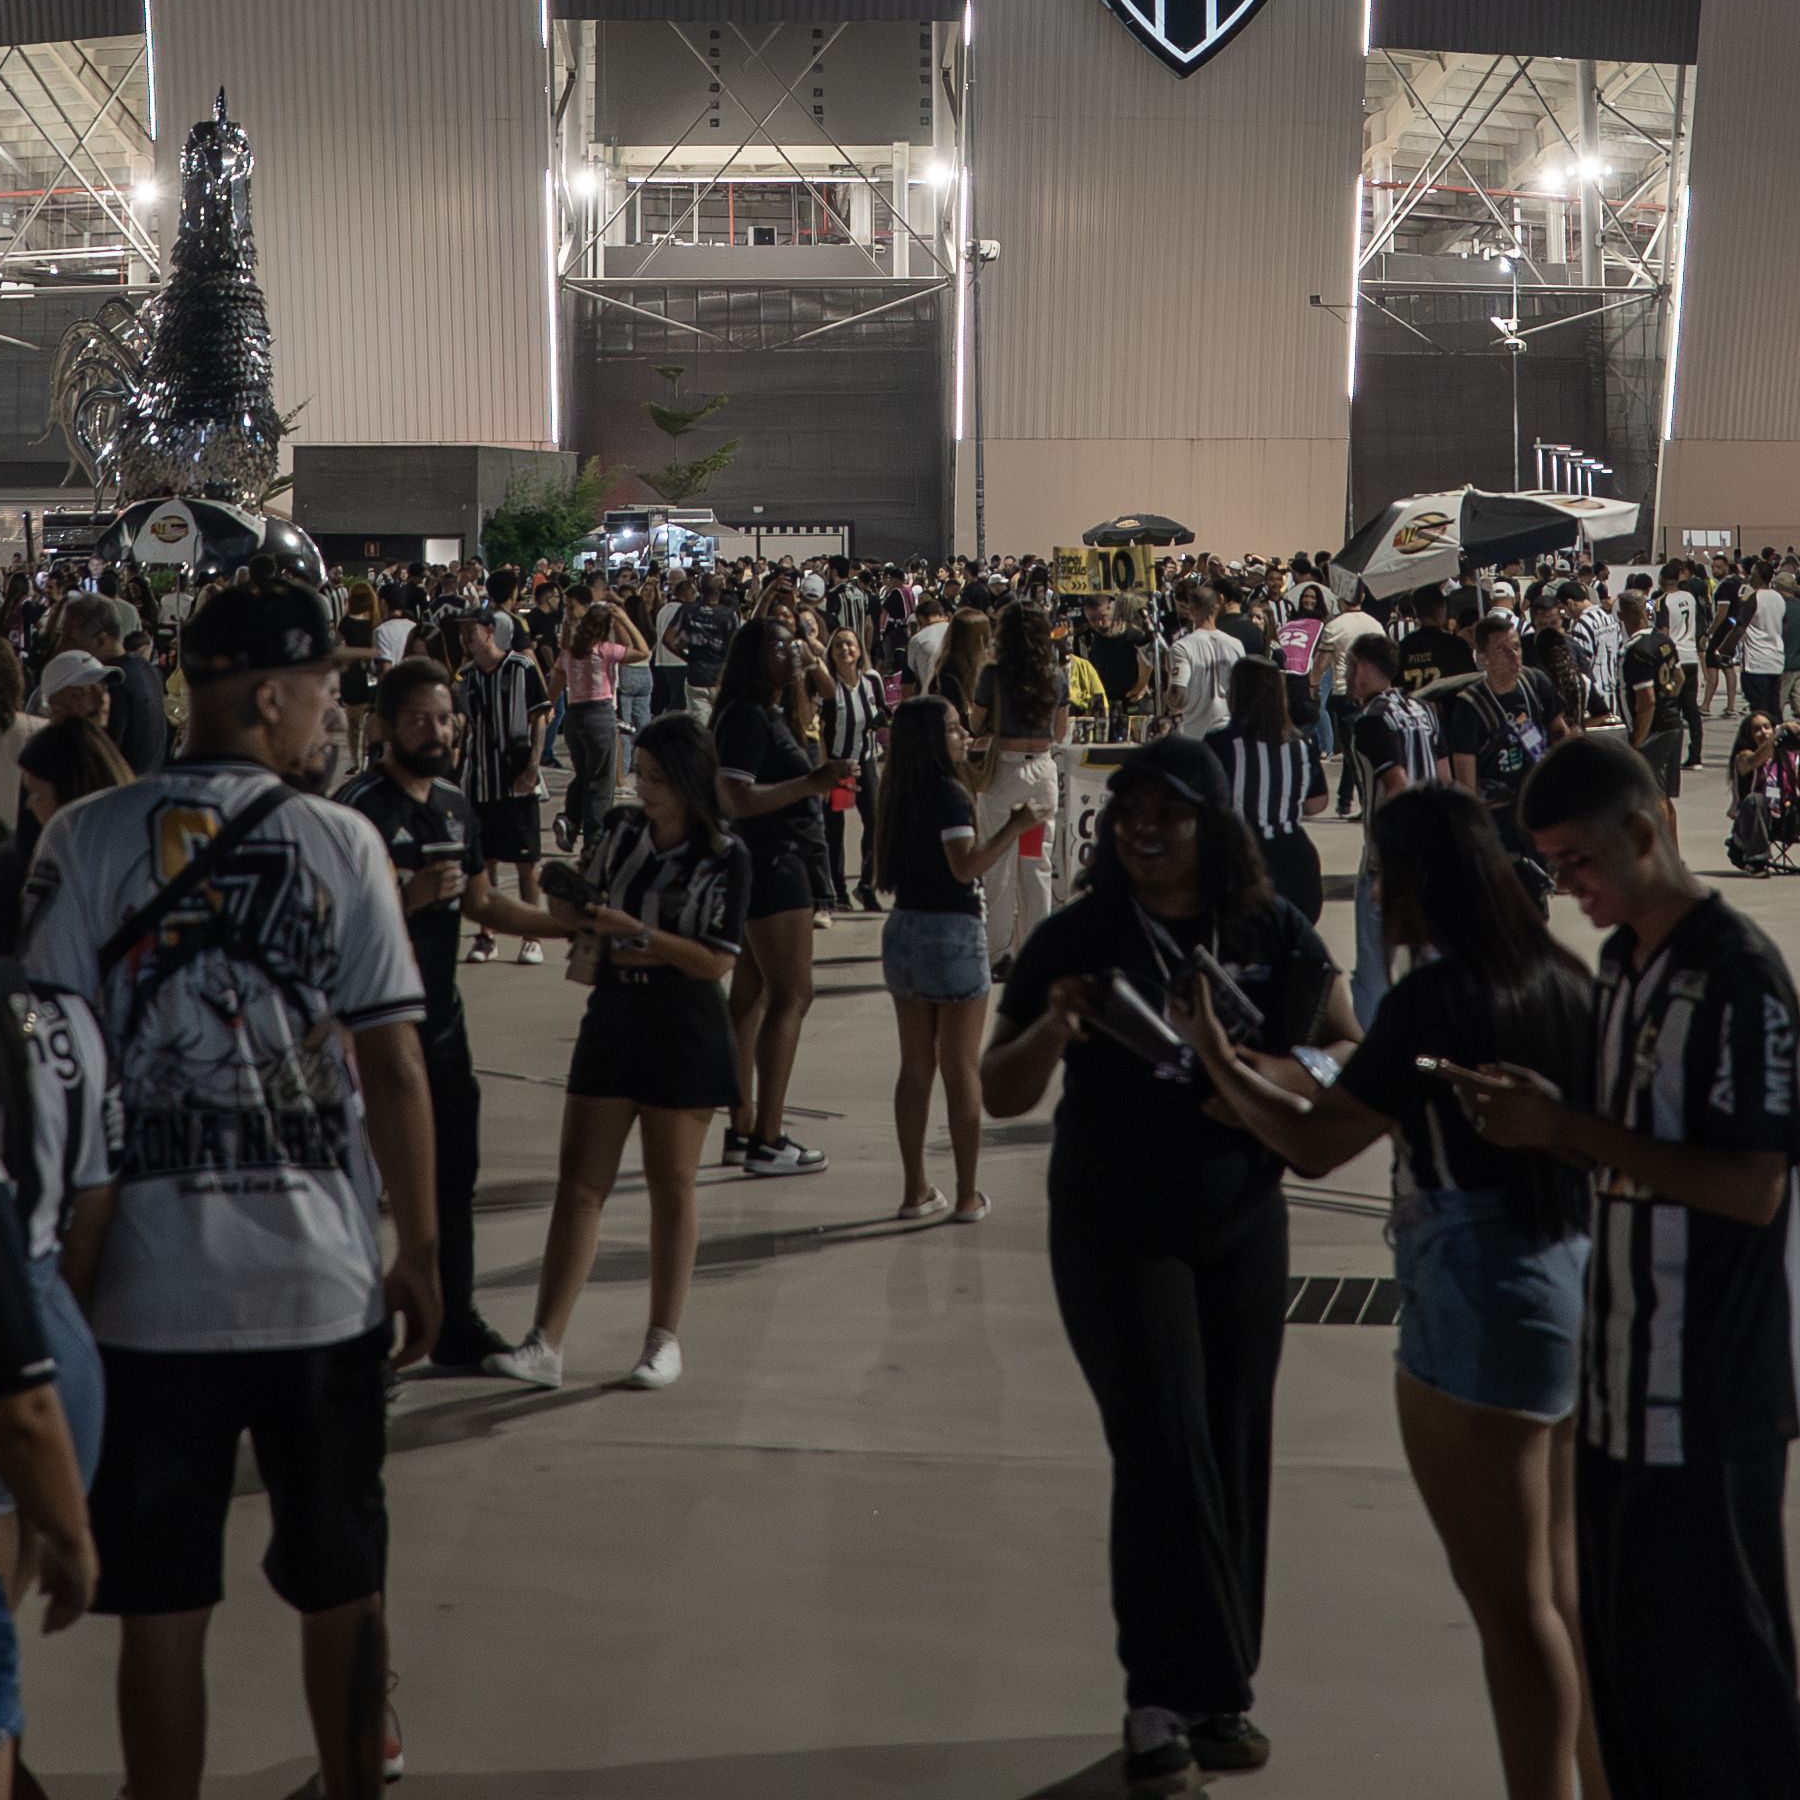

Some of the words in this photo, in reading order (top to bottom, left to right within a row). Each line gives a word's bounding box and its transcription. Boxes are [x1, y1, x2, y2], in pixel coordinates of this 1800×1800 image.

[1097, 550, 1135, 590] 10
[1279, 631, 1308, 648] 22
[1763, 993, 1794, 1116] MRV
